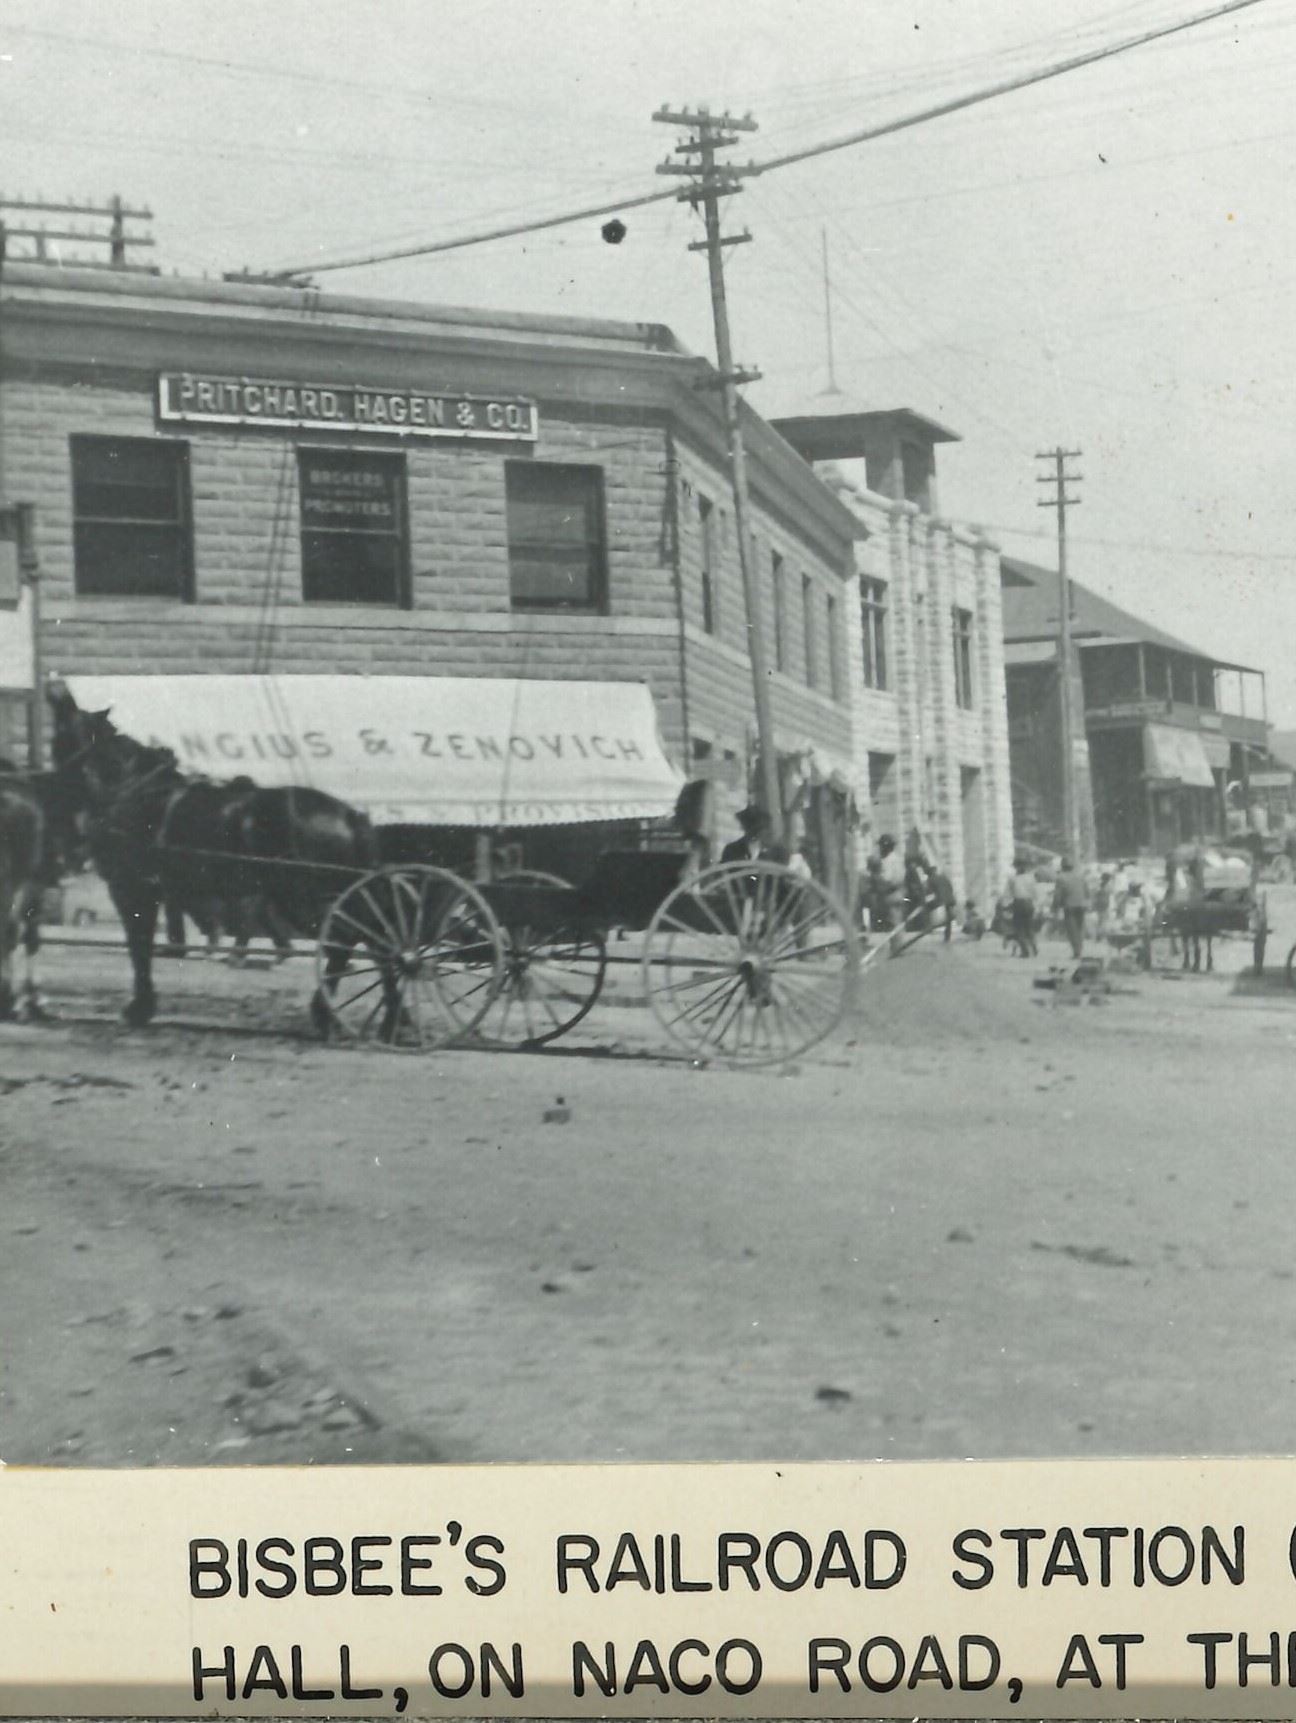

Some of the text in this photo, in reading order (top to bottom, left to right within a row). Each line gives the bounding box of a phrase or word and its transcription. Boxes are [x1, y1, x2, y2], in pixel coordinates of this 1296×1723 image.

[354, 394, 445, 427] HAGEN
[456, 401, 475, 428] &
[486, 402, 529, 430] CO.
[358, 728, 393, 756] &
[412, 731, 645, 761] ZENOVICH
